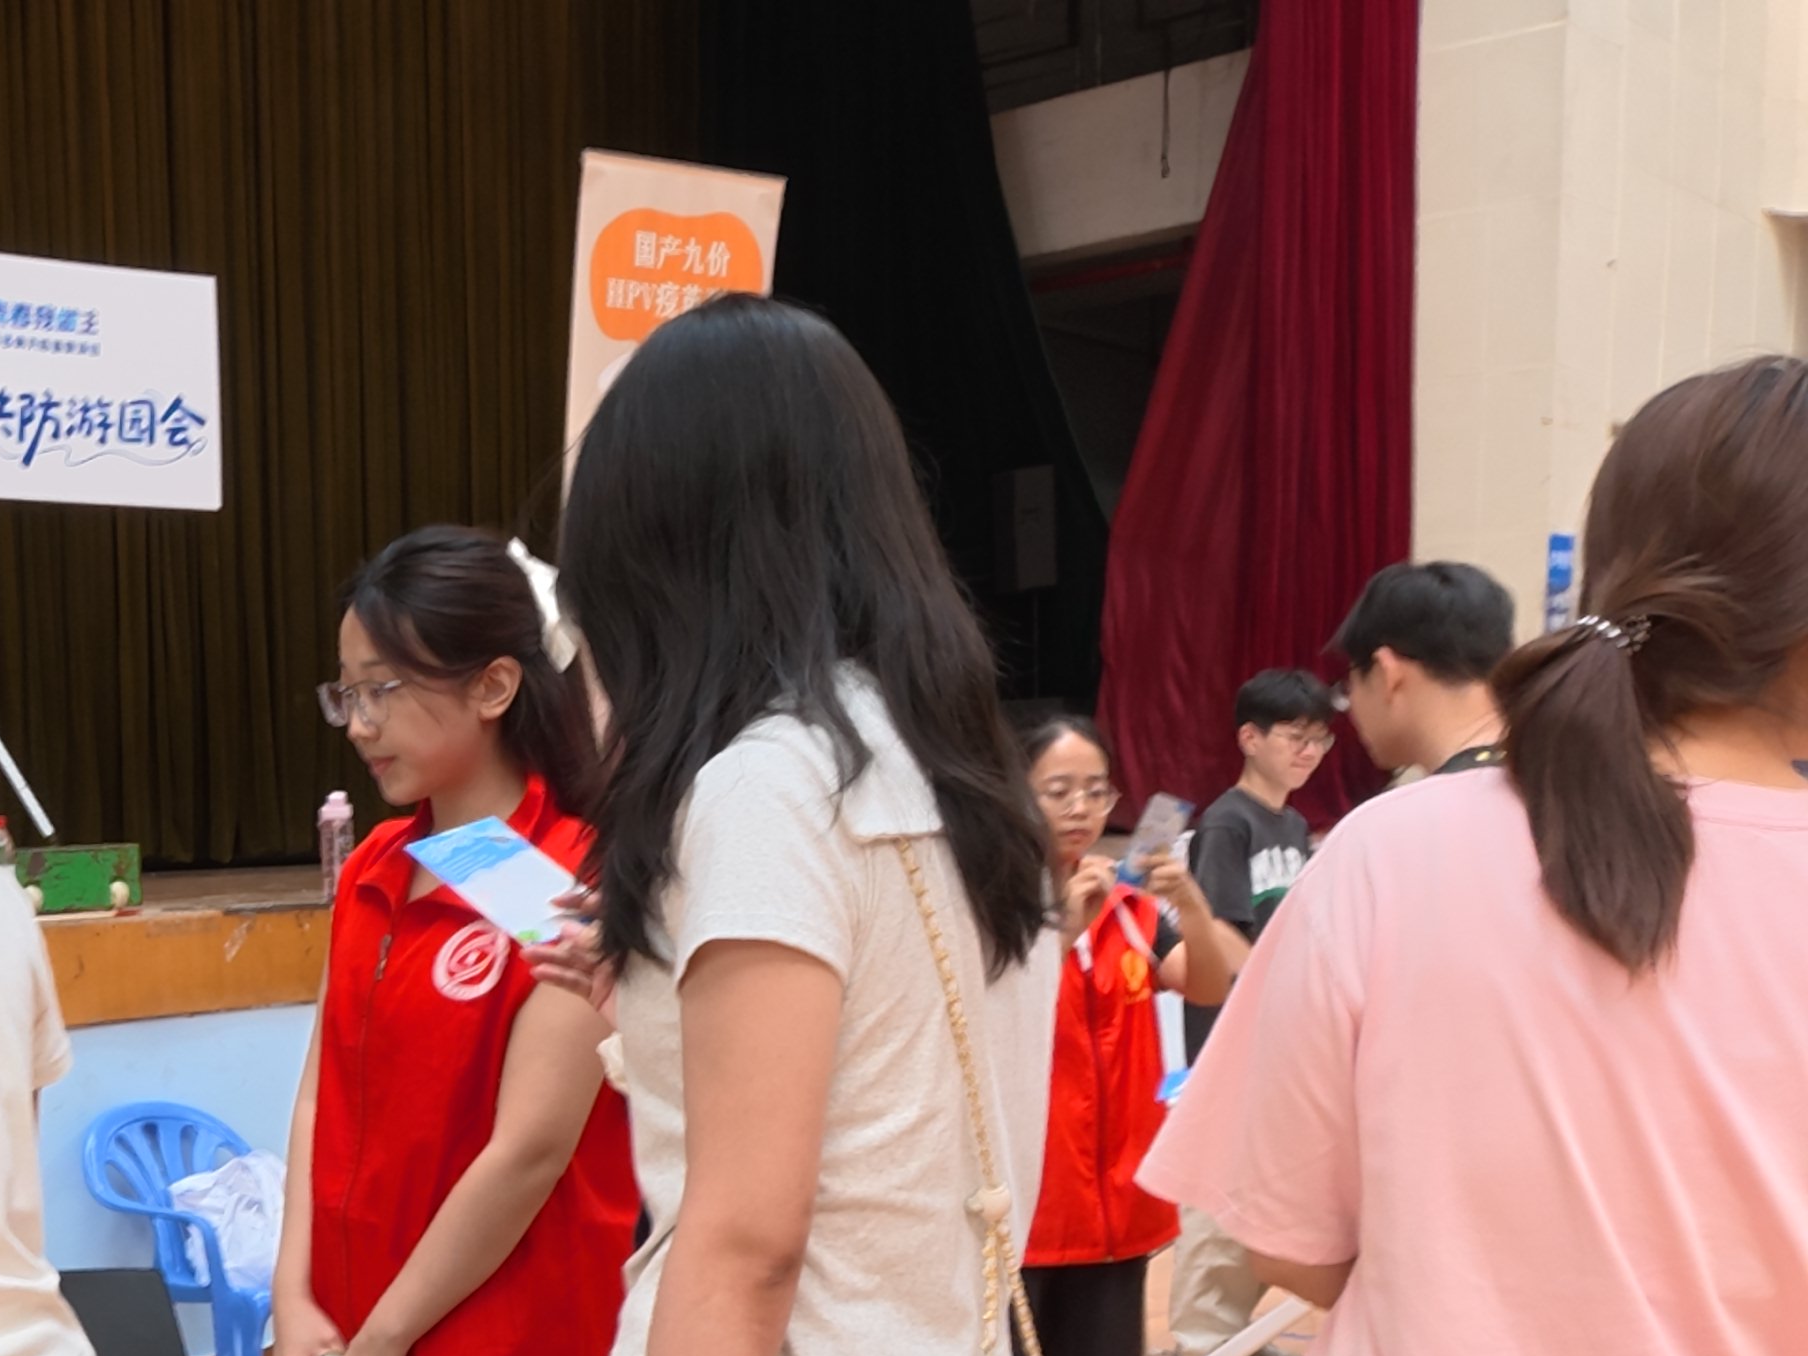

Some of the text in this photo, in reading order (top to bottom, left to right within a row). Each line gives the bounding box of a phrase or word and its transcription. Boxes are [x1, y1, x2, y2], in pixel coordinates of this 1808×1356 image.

[634, 230, 731, 278] 国产九价
[605, 276, 727, 319] HPV疫苗
